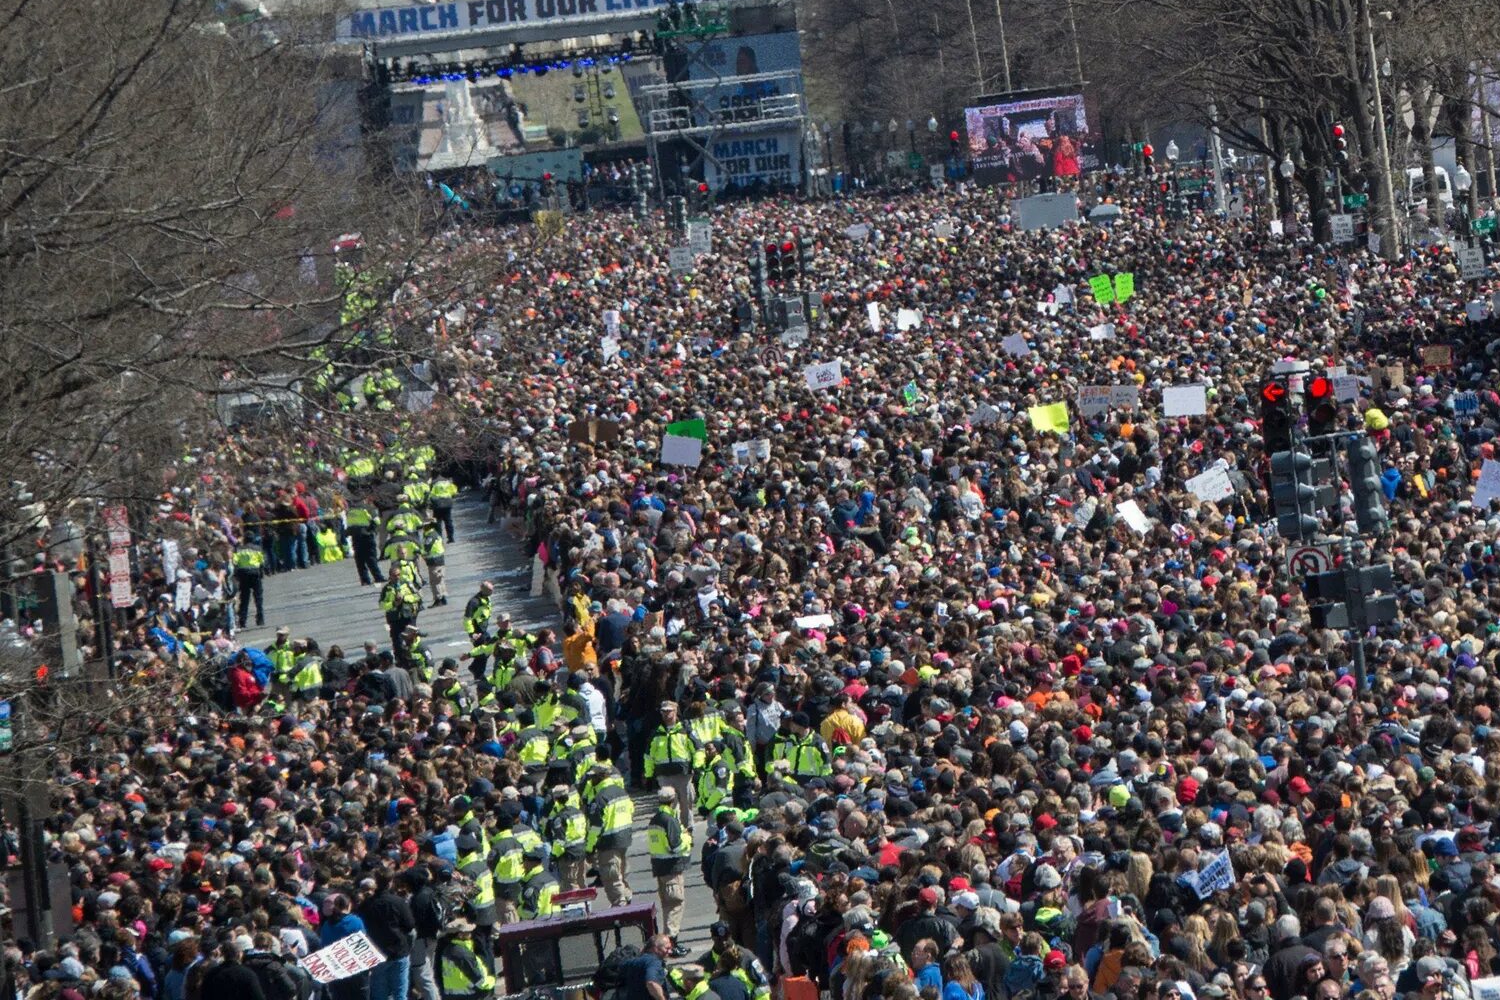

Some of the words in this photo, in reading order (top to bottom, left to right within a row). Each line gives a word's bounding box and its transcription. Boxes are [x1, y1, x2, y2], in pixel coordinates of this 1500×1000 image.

[350, 2, 459, 37] MARCH
[714, 138, 778, 158] MARCH
[755, 154, 792, 172] OUR
[345, 934, 370, 956] END
[360, 951, 381, 968] GUN
